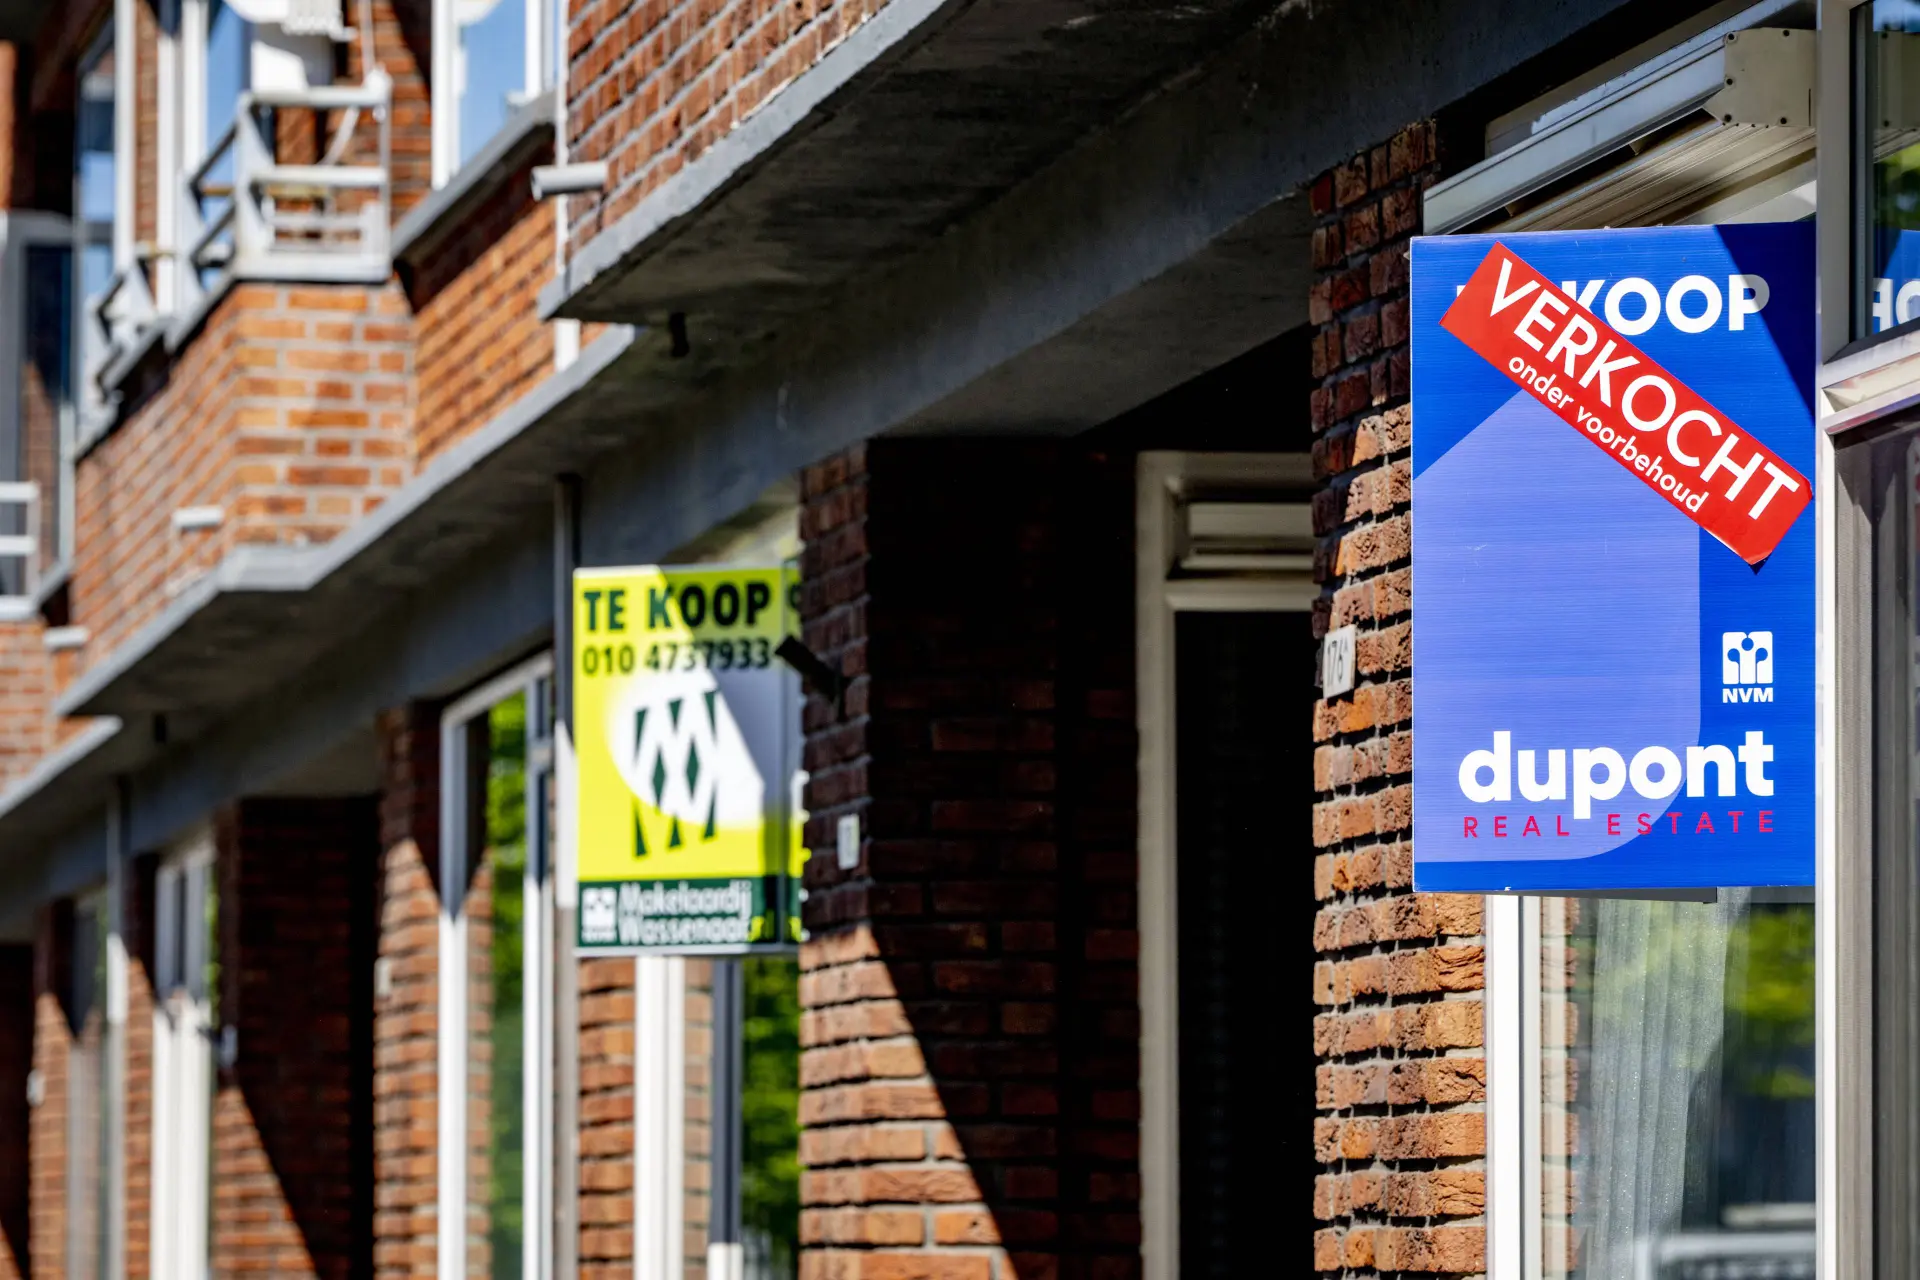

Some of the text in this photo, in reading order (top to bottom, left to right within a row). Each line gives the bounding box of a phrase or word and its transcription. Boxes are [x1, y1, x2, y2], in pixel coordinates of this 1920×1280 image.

[1489, 258, 1800, 520] VERKOCHT
[1509, 356, 1710, 513] onder voorbehoud
[584, 589, 625, 631] TE
[649, 583, 771, 629] KOOP
[583, 638, 770, 675] 010 4737933
[1722, 687, 1773, 703] NVM
[1458, 731, 1774, 819] dupont
[1464, 810, 1774, 838] REAL ESTATE
[619, 880, 752, 920] Makelaardij
